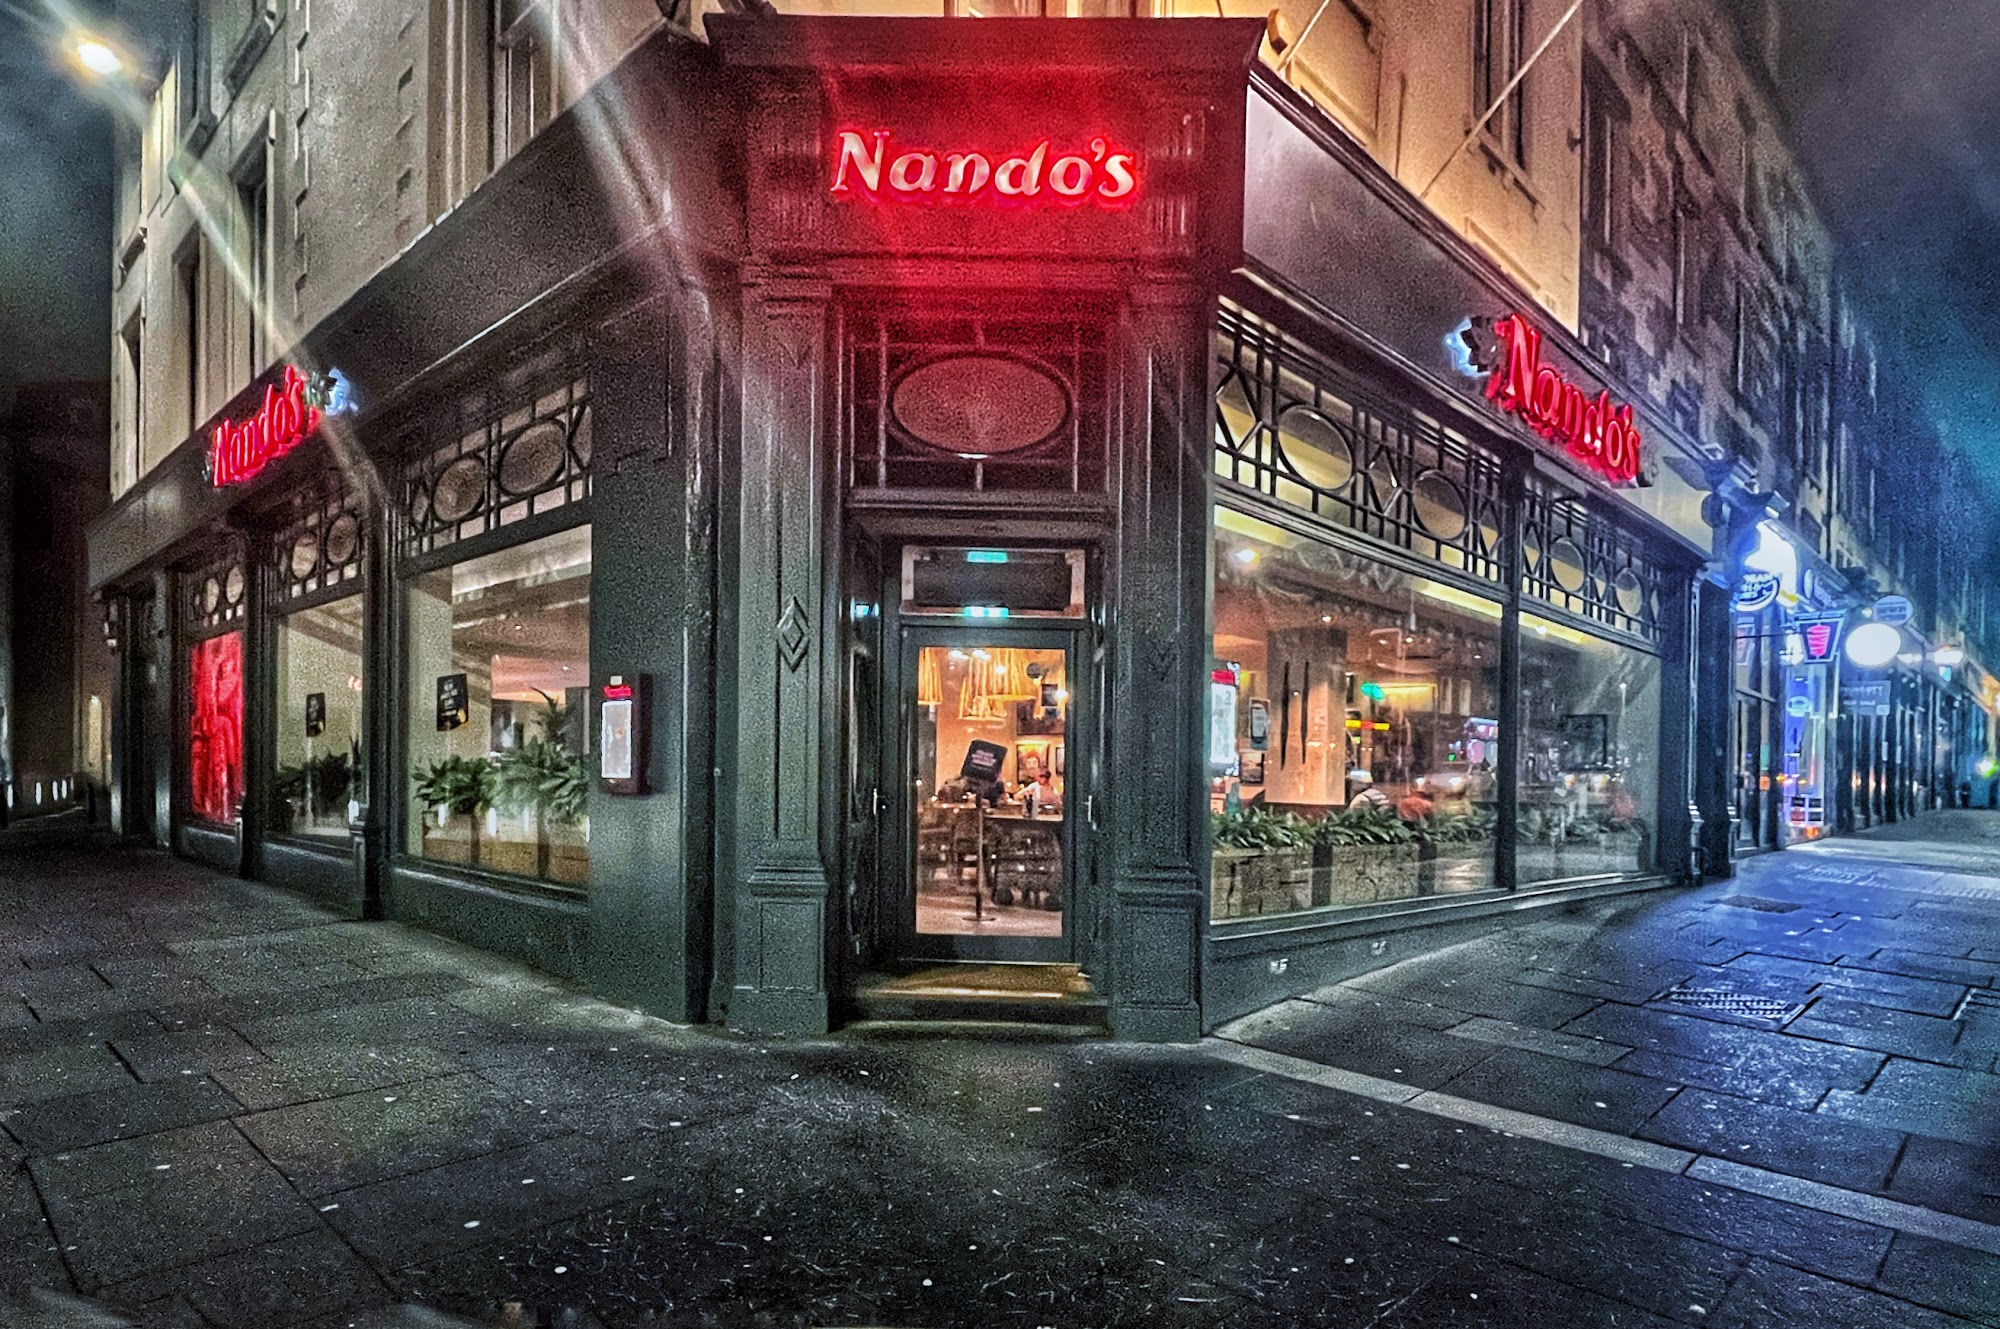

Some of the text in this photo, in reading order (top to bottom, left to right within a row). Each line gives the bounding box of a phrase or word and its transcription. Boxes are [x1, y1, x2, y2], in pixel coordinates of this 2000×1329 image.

[831, 130, 1135, 198] Nando's
[213, 365, 305, 488] Nando's
[1505, 313, 1641, 480] Nando's
